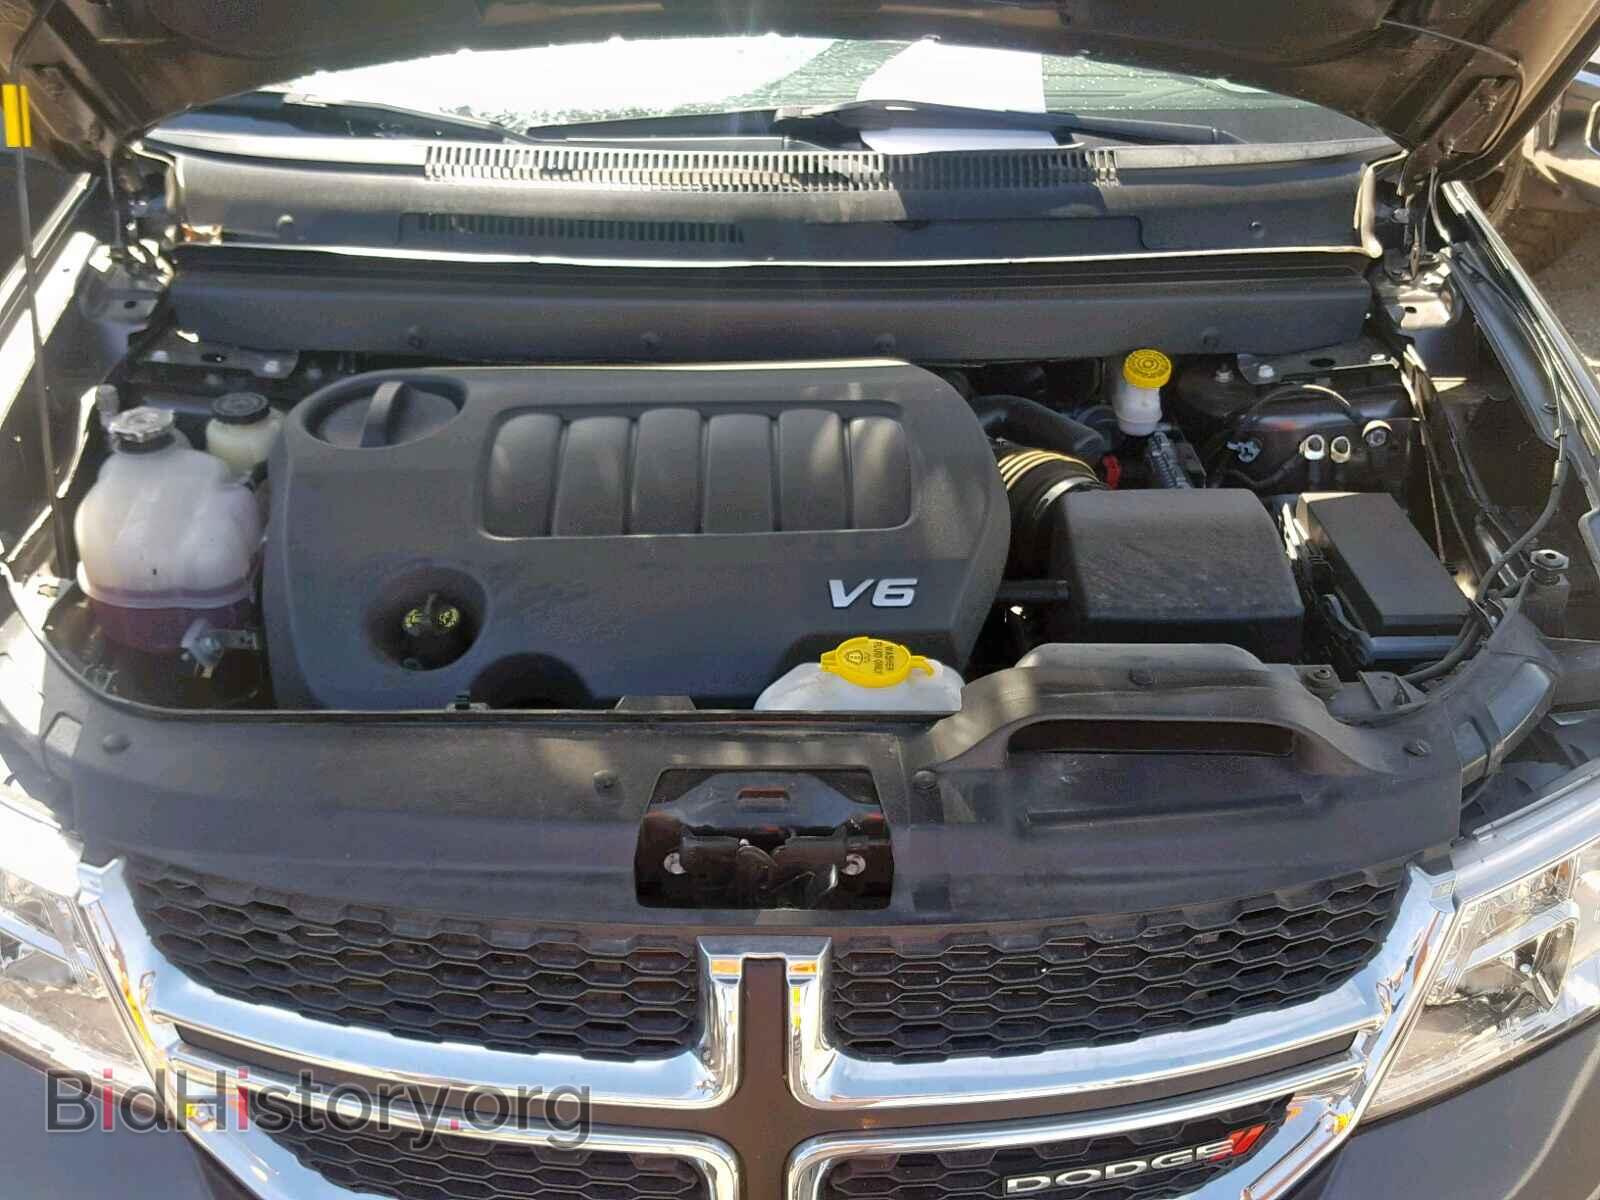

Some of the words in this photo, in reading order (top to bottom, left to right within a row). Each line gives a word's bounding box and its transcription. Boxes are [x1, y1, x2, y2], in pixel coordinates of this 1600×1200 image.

[828, 578, 919, 608] V6
[884, 646, 896, 671] WASHER
[1006, 1138, 1234, 1194] DODGE
